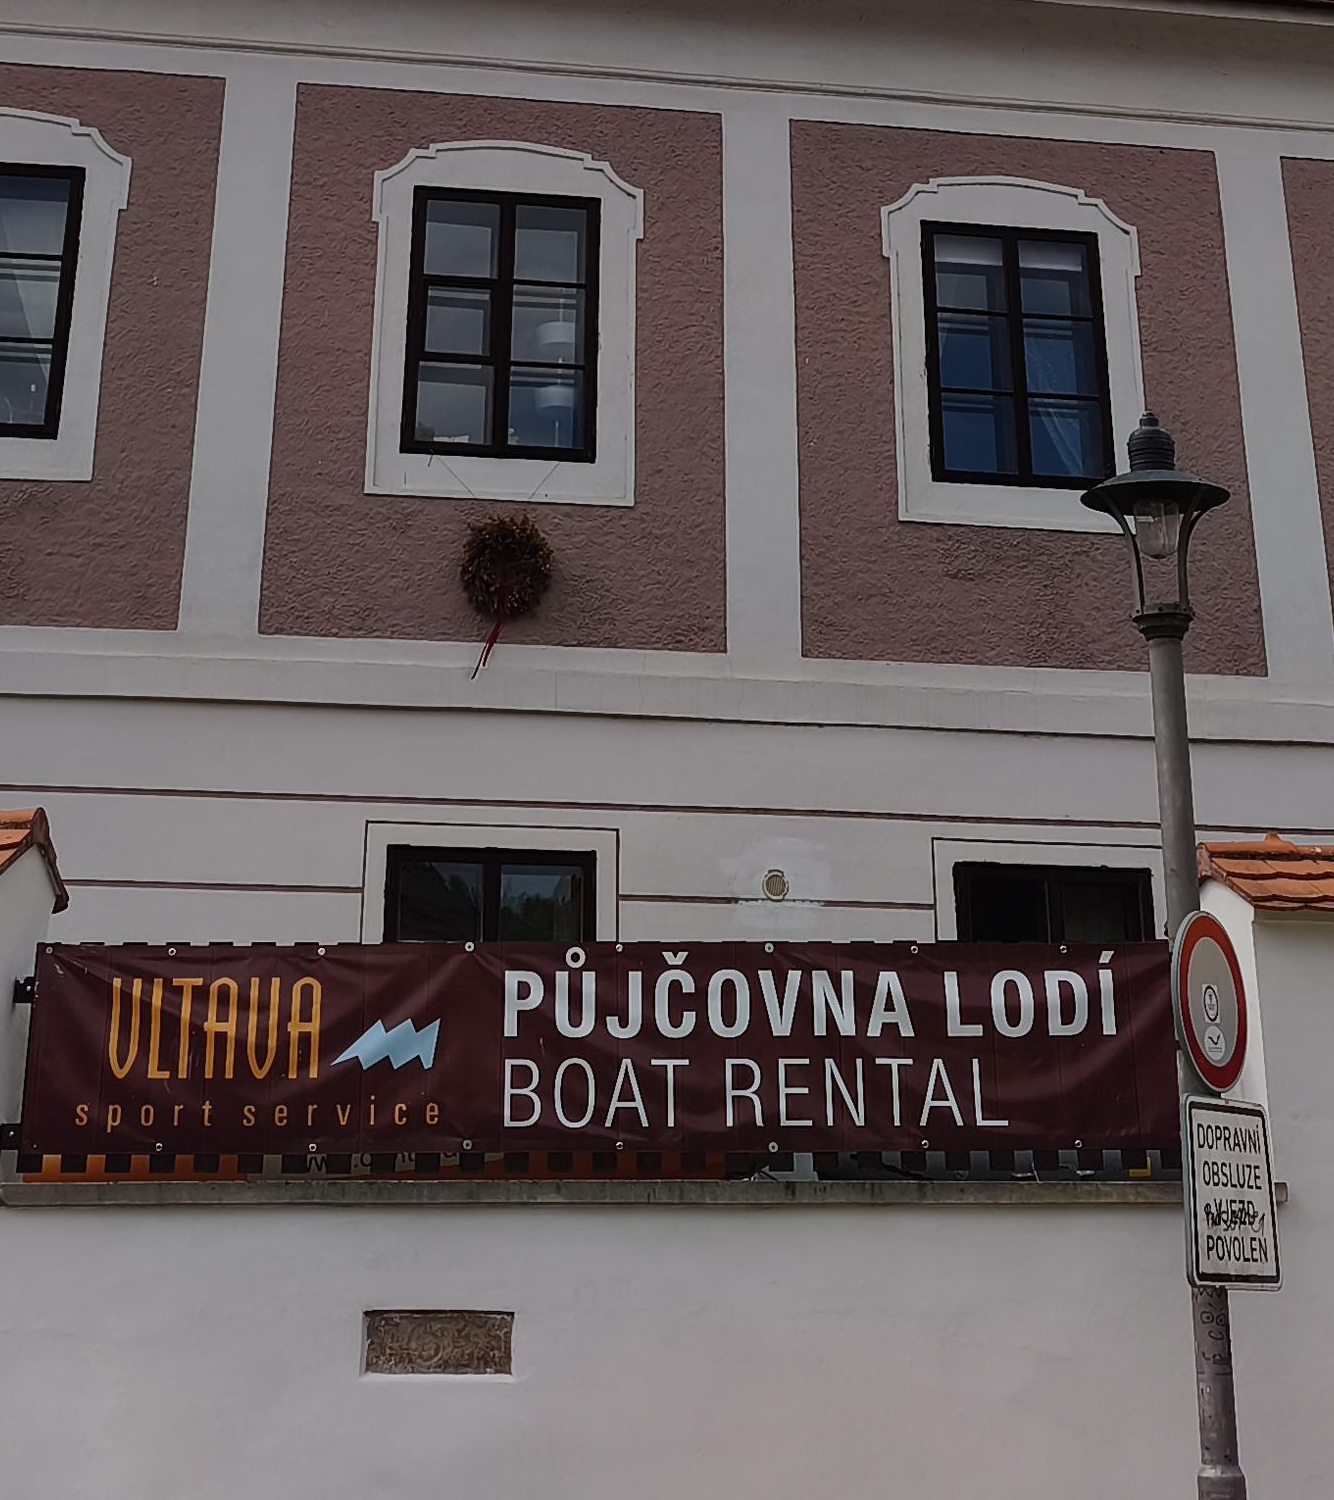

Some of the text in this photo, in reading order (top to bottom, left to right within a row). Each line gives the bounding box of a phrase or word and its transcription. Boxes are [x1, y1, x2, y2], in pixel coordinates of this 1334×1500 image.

[503, 946, 1117, 1038] PŮJČOVNA LODÍ
[108, 976, 322, 1079] VLTAVA
[503, 1058, 1009, 1129] BOAT RENTAL
[75, 1095, 440, 1132] sport service
[1197, 1123, 1261, 1154] DOPRAVNÍ
[1203, 1160, 1262, 1190] OBSLUZE
[1207, 1235, 1268, 1263] POVOLEN
